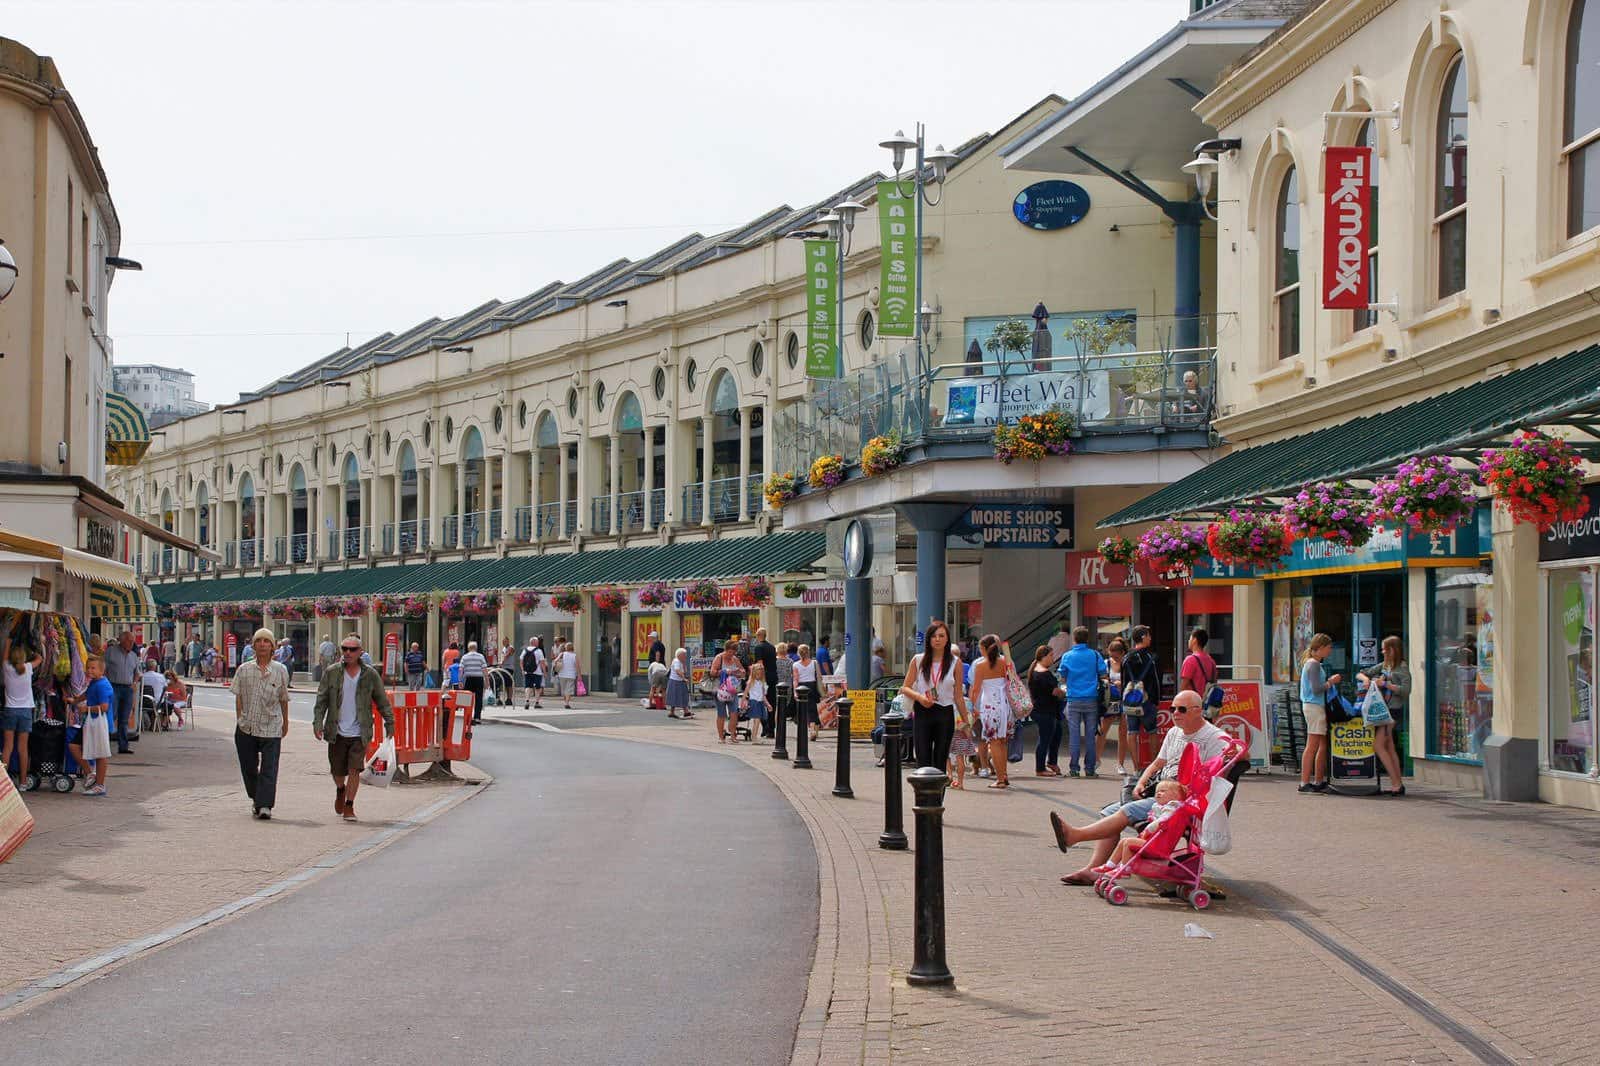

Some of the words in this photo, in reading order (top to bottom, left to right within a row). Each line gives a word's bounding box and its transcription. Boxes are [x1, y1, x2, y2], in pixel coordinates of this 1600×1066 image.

[1036, 197, 1055, 206] Fleet
[1056, 195, 1077, 204] Walk
[1039, 378, 1097, 400] Wak
[971, 510, 1012, 525] MORE
[1016, 510, 1062, 525] SHOPS
[983, 527, 1050, 543] UPSTAIRS
[1078, 557, 1110, 586] KFC
[1218, 700, 1256, 715] alue!
[1334, 726, 1373, 739] Cash
[1334, 739, 1373, 749] Machine
[1342, 747, 1363, 756] Here
